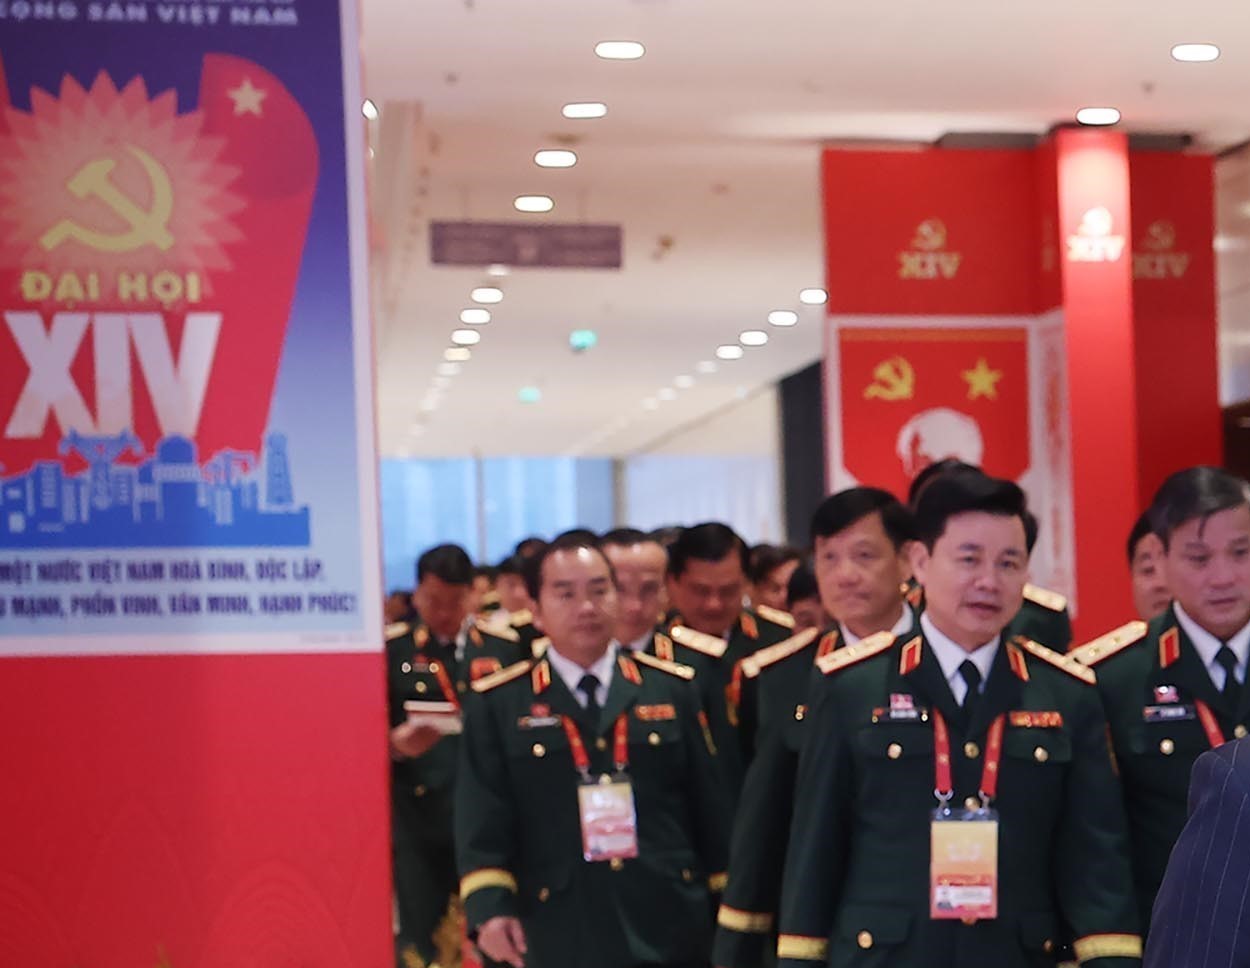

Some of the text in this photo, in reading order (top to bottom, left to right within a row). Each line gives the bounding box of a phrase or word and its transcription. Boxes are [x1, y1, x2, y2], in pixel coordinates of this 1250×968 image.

[230, 6, 298, 25] NAM
[1067, 234, 1125, 263] XIV
[899, 252, 962, 280] XIV
[20, 268, 201, 311] ĐẠI HỘI
[3, 310, 224, 440] XIV
